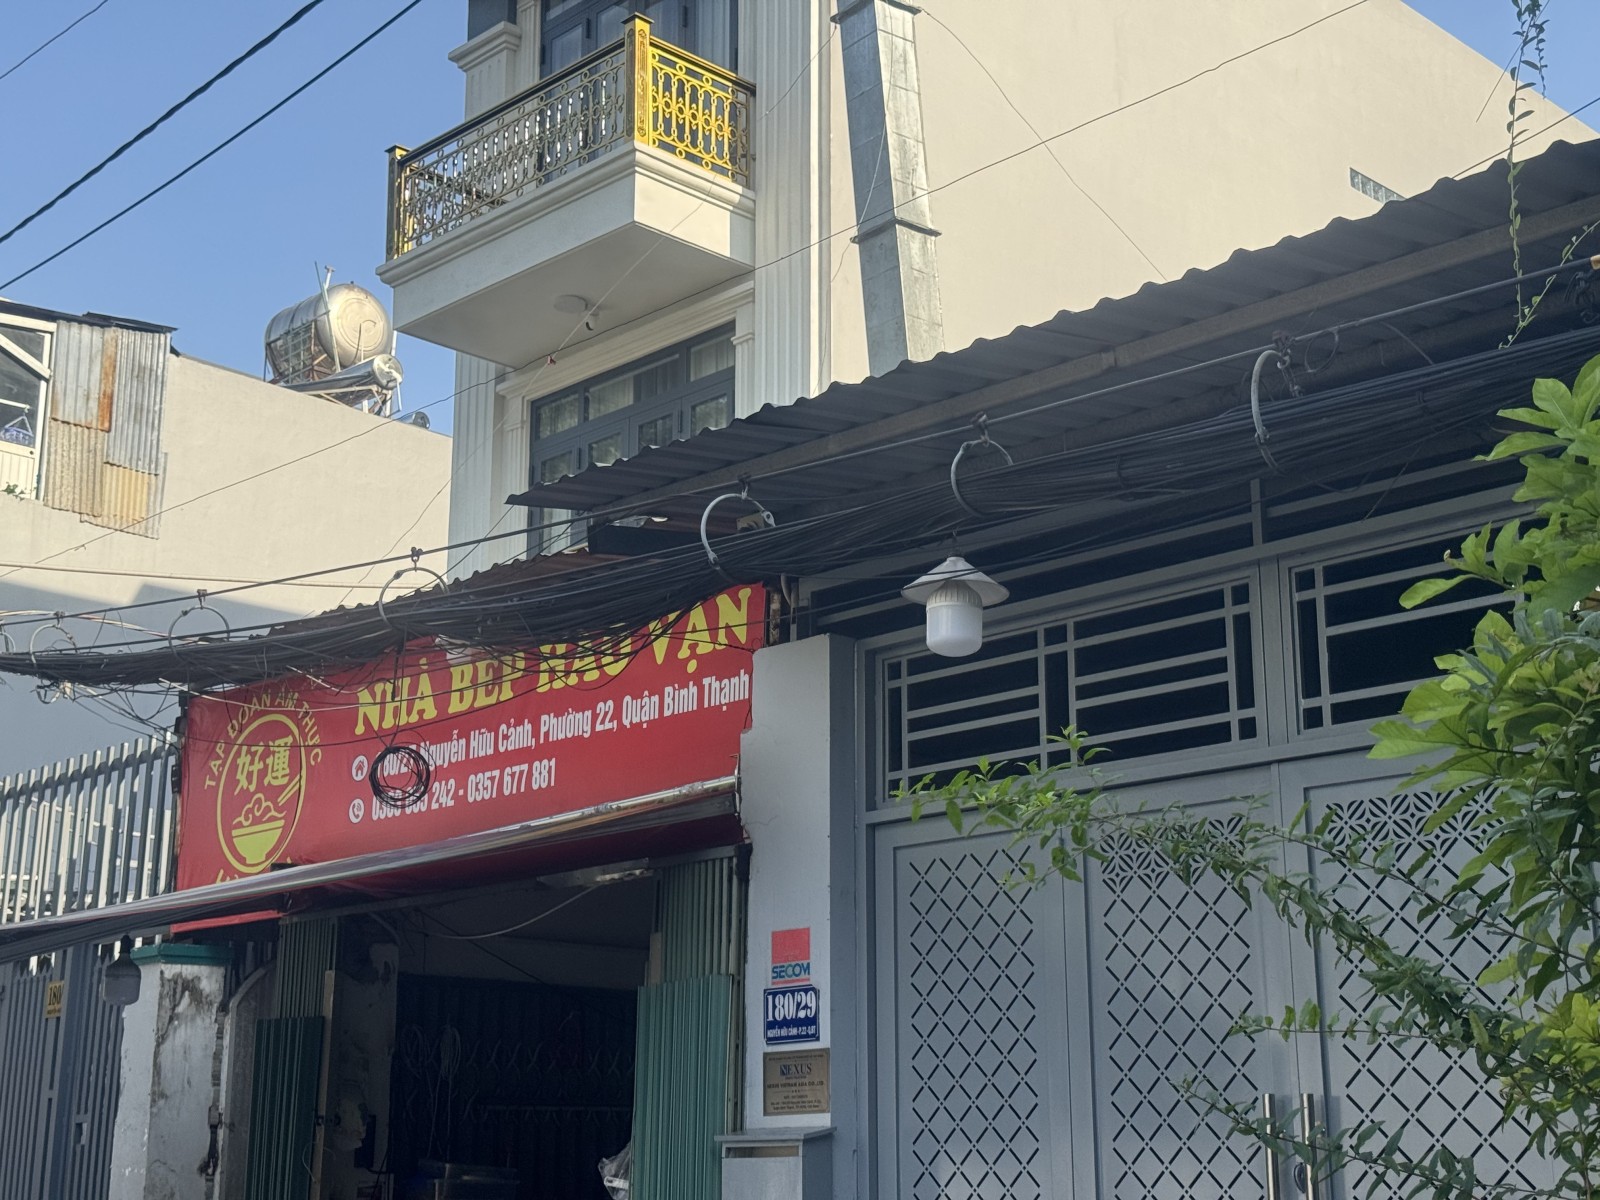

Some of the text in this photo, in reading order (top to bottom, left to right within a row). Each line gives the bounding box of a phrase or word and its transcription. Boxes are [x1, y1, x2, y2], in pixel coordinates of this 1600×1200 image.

[469, 727, 495, 759] Hữu
[498, 717, 536, 751] Cảnh,
[540, 707, 592, 744] Phường
[595, 699, 619, 732] 22,
[621, 690, 660, 729] Quận
[663, 680, 698, 717] Bình
[702, 668, 750, 712] Thạnh
[234, 734, 294, 796] 好運
[431, 778, 456, 810] 242
[467, 769, 501, 804] 0357
[503, 763, 529, 796] 677
[531, 757, 556, 791] 881
[771, 962, 811, 980] SECOM
[766, 990, 817, 1022] 180/29
[780, 1063, 812, 1076] NEXUS
